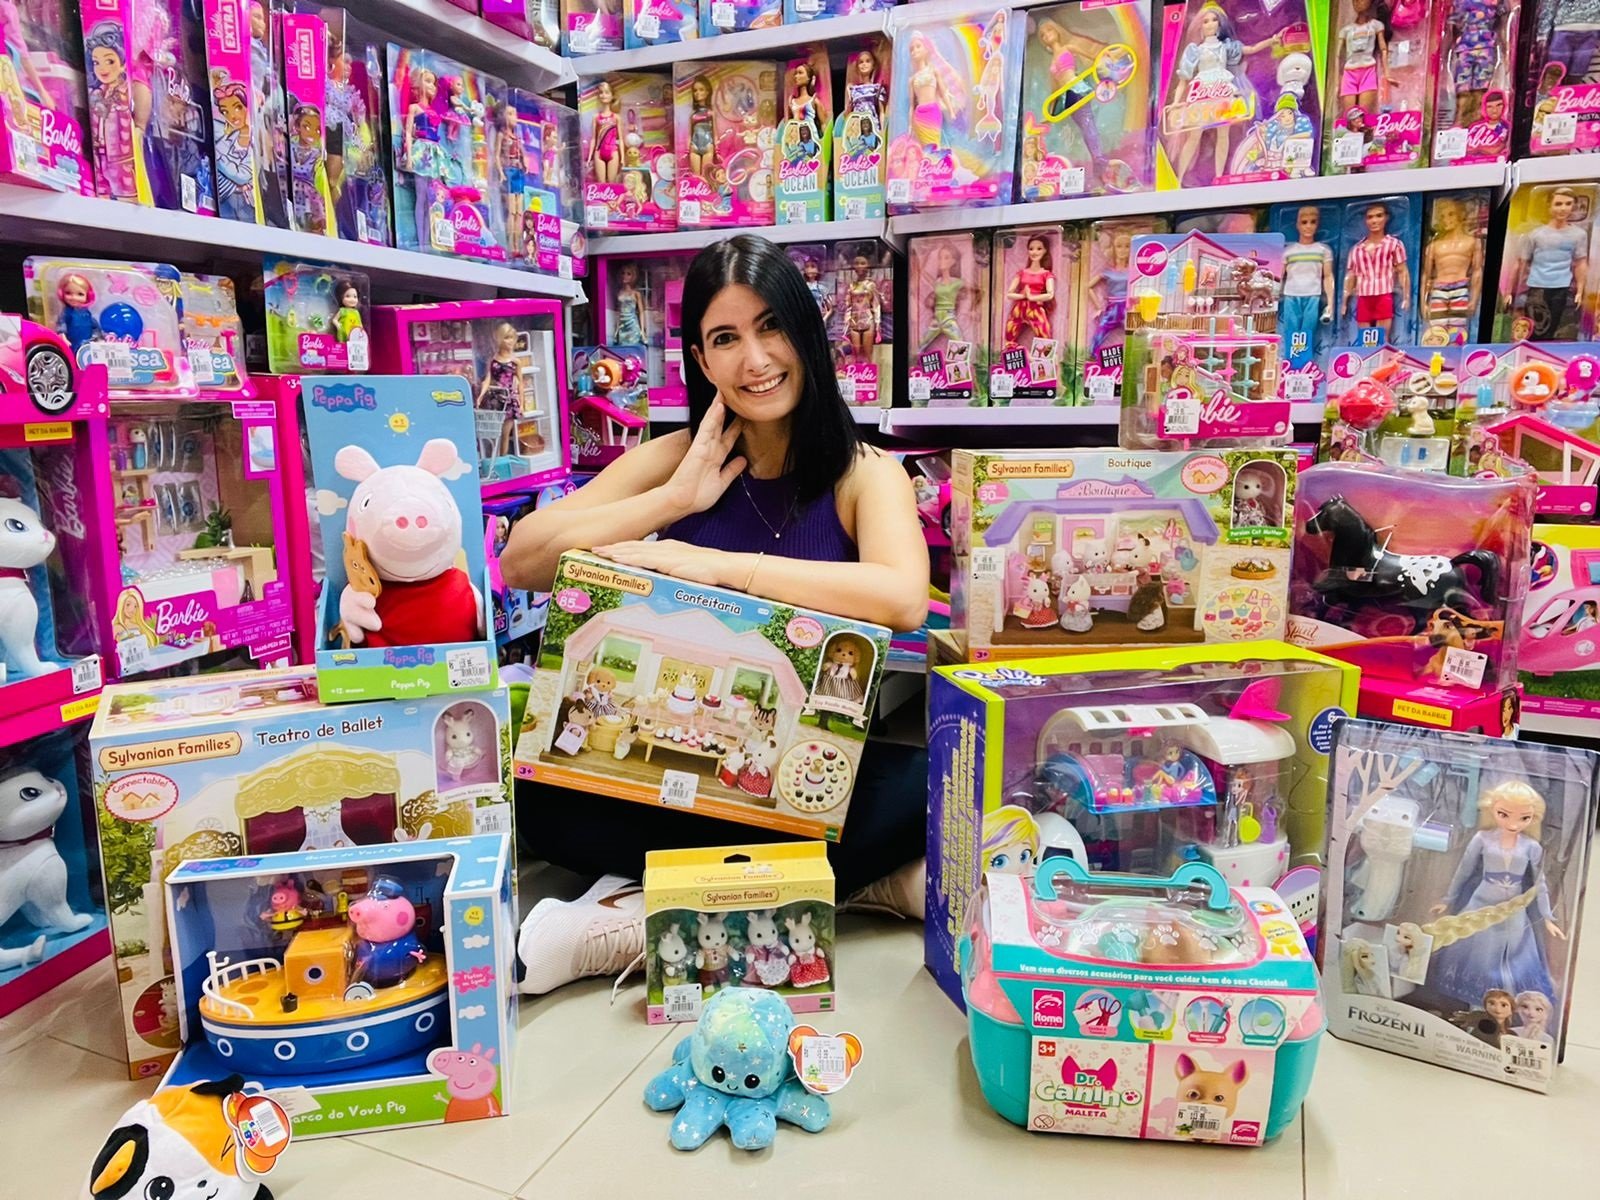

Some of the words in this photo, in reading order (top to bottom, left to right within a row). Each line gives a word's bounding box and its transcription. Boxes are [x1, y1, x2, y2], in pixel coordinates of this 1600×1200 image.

[223, 5, 236, 48] EXTRA
[301, 34, 313, 74] EXTRA
[1187, 80, 1234, 102] Barbie
[41, 109, 82, 153] Barbie
[1373, 113, 1421, 137] Barbie
[779, 159, 813, 179] Barbie
[839, 153, 873, 174] Barbie
[919, 160, 951, 177] Barbie
[783, 174, 817, 194] OCEAN
[843, 168, 877, 188] OCEAN
[586, 184, 618, 202] Barbie
[679, 180, 711, 198] Barbie
[454, 210, 480, 231] Barbie
[537, 213, 560, 234] Barbie
[1292, 332, 1307, 346] 60
[1363, 329, 1378, 344] 60
[923, 353, 939, 362] MADE
[1006, 350, 1023, 360] MADE
[1101, 347, 1121, 357] MADE
[924, 364, 940, 373] MOVE
[1006, 362, 1024, 371] MOVE
[1103, 357, 1122, 367] MOVE
[846, 364, 877, 381] Barbie
[314, 386, 353, 409] Peppa
[354, 386, 375, 410] Pig
[992, 464, 1032, 475] Sylvanian
[1034, 463, 1068, 473] Families
[1108, 458, 1152, 469] Boutique
[53, 456, 86, 540] Barbie
[981, 490, 996, 500] 30
[1079, 484, 1130, 498] Boutique
[568, 564, 610, 583] Sylvanian
[612, 574, 647, 591] Families
[560, 596, 577, 608] 85
[675, 589, 741, 615] Confeitaria
[156, 599, 208, 634] Barbie
[384, 650, 416, 665] Peppa
[417, 648, 433, 663] Pig
[391, 680, 415, 691] Peppa
[417, 679, 430, 689] Pig
[1397, 705, 1410, 713] PET
[1412, 707, 1421, 715] DA
[1423, 710, 1447, 721] BARBIE
[257, 730, 310, 746] Teatro
[317, 724, 335, 736] de
[342, 716, 383, 733] Ballet
[108, 747, 173, 766] Sylvanian
[178, 739, 231, 756] Families
[112, 777, 168, 794] Connectable!
[707, 893, 742, 903] Sylvanian
[744, 891, 773, 901] Families
[1020, 964, 1036, 972] Vem
[1057, 967, 1088, 977] diversos
[1091, 970, 1132, 980] acessórios
[1134, 974, 1153, 982] para
[1202, 976, 1219, 984] bem
[1221, 977, 1231, 985] do
[1034, 1012, 1063, 1023] Roma
[1348, 1006, 1412, 1032] FROZEN
[1414, 1022, 1426, 1037] II
[1040, 1045, 1055, 1053] 3+
[1076, 1073, 1102, 1086] Dr.
[1035, 1079, 1142, 1108] Canino
[290, 1111, 322, 1124] arco
[328, 1110, 344, 1120] do
[348, 1101, 383, 1117] Vovô
[387, 1100, 406, 1115] Pig
[1065, 1108, 1107, 1118] MALETA
